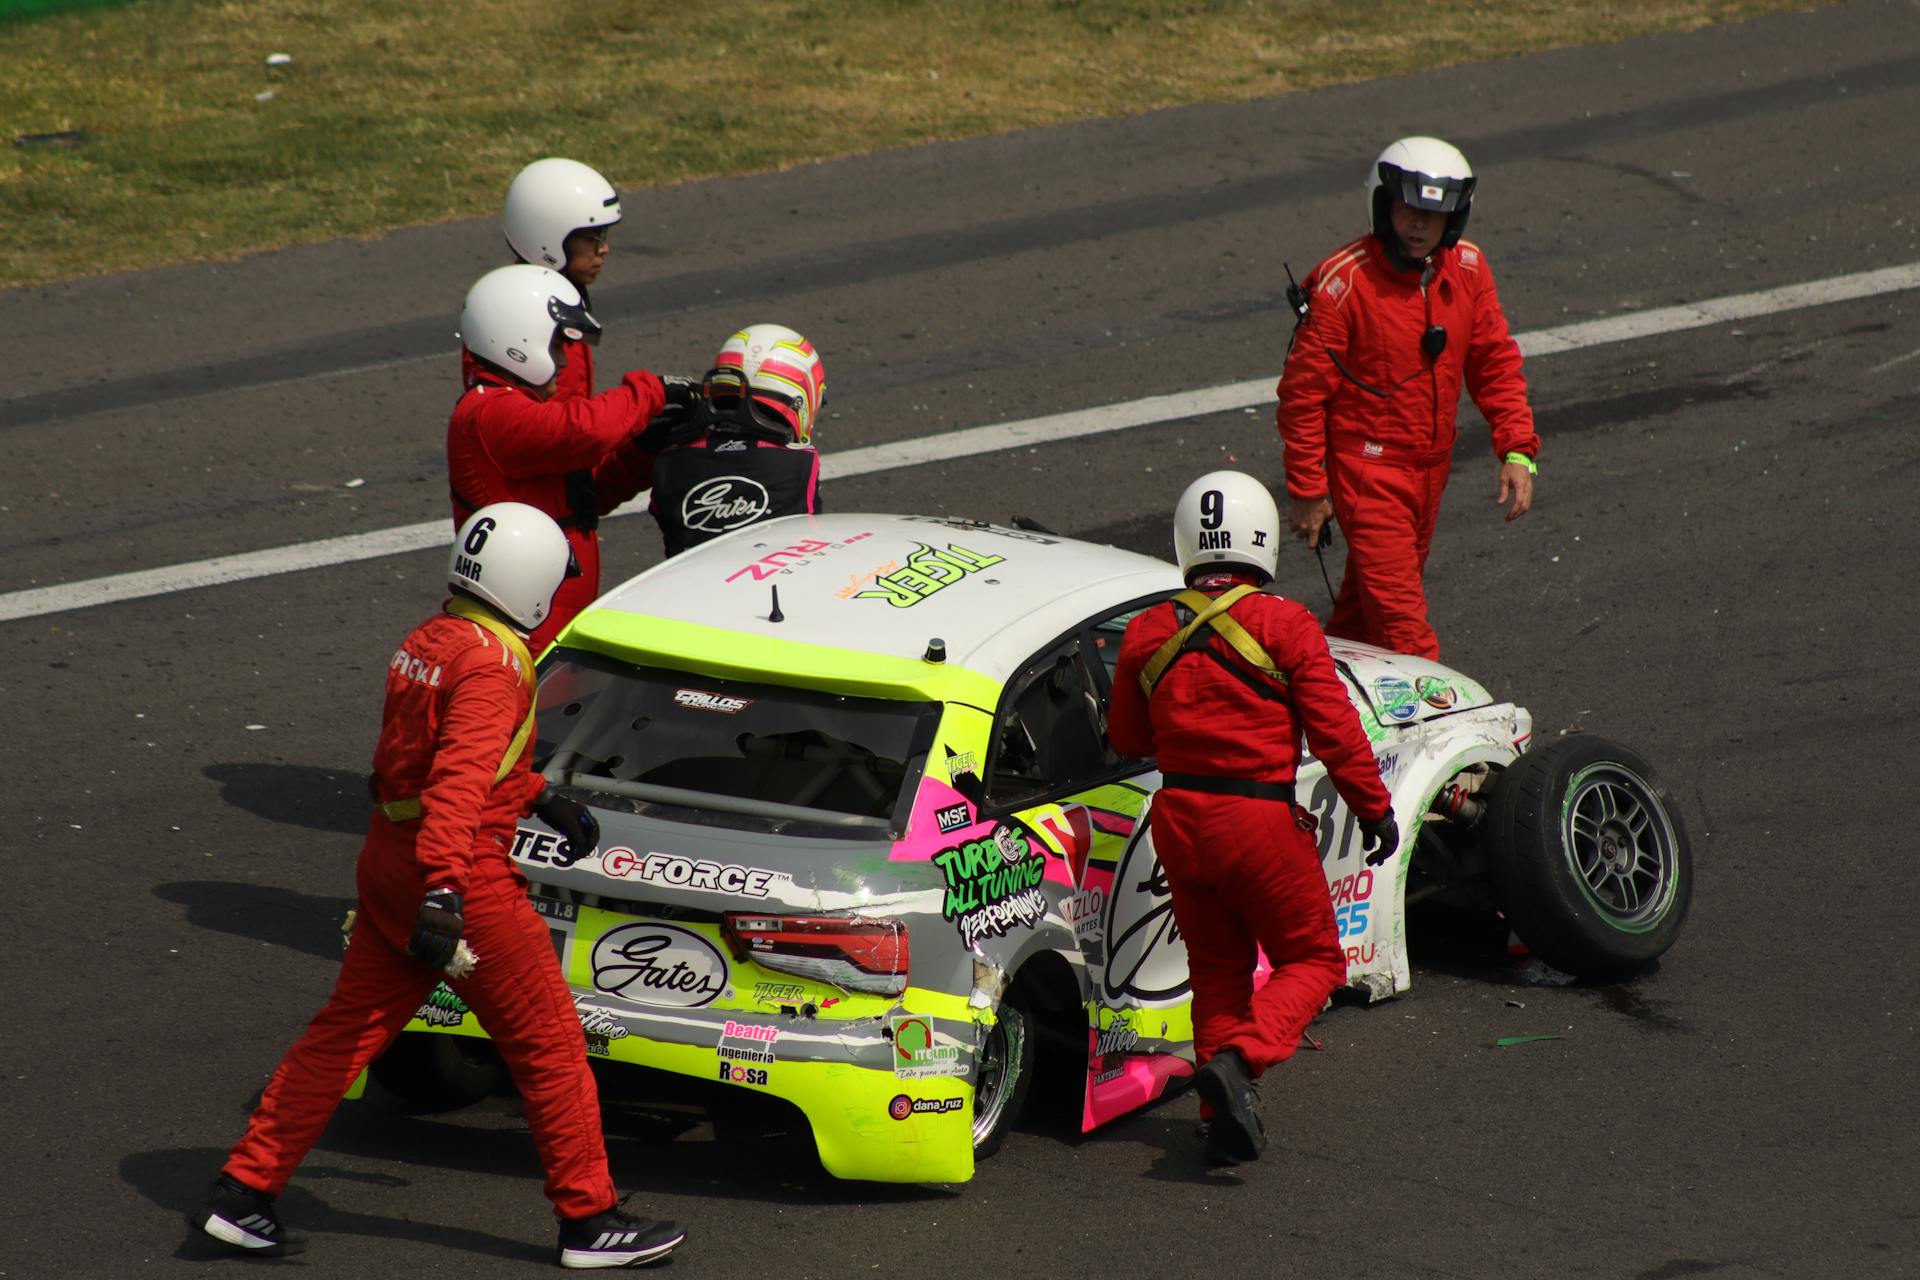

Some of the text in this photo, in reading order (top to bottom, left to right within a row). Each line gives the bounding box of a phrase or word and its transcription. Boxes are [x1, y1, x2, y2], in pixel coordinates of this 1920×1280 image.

[684, 480, 768, 530] Gates
[1200, 490, 1224, 530] 9
[464, 516, 496, 556] 6
[1199, 531, 1231, 550] AHR
[455, 554, 483, 582] AHR
[724, 539, 832, 583] RUZ
[853, 541, 1006, 608] TIGER
[945, 751, 976, 774] TIGER
[937, 805, 969, 830] MSF
[602, 849, 774, 897] G-FORCE
[945, 857, 1044, 918] ALL TUNING
[554, 902, 574, 918] 1.8
[593, 934, 719, 1003] Gates
[752, 982, 804, 1001] TIGER
[912, 1099, 963, 1112] dana_ruz
